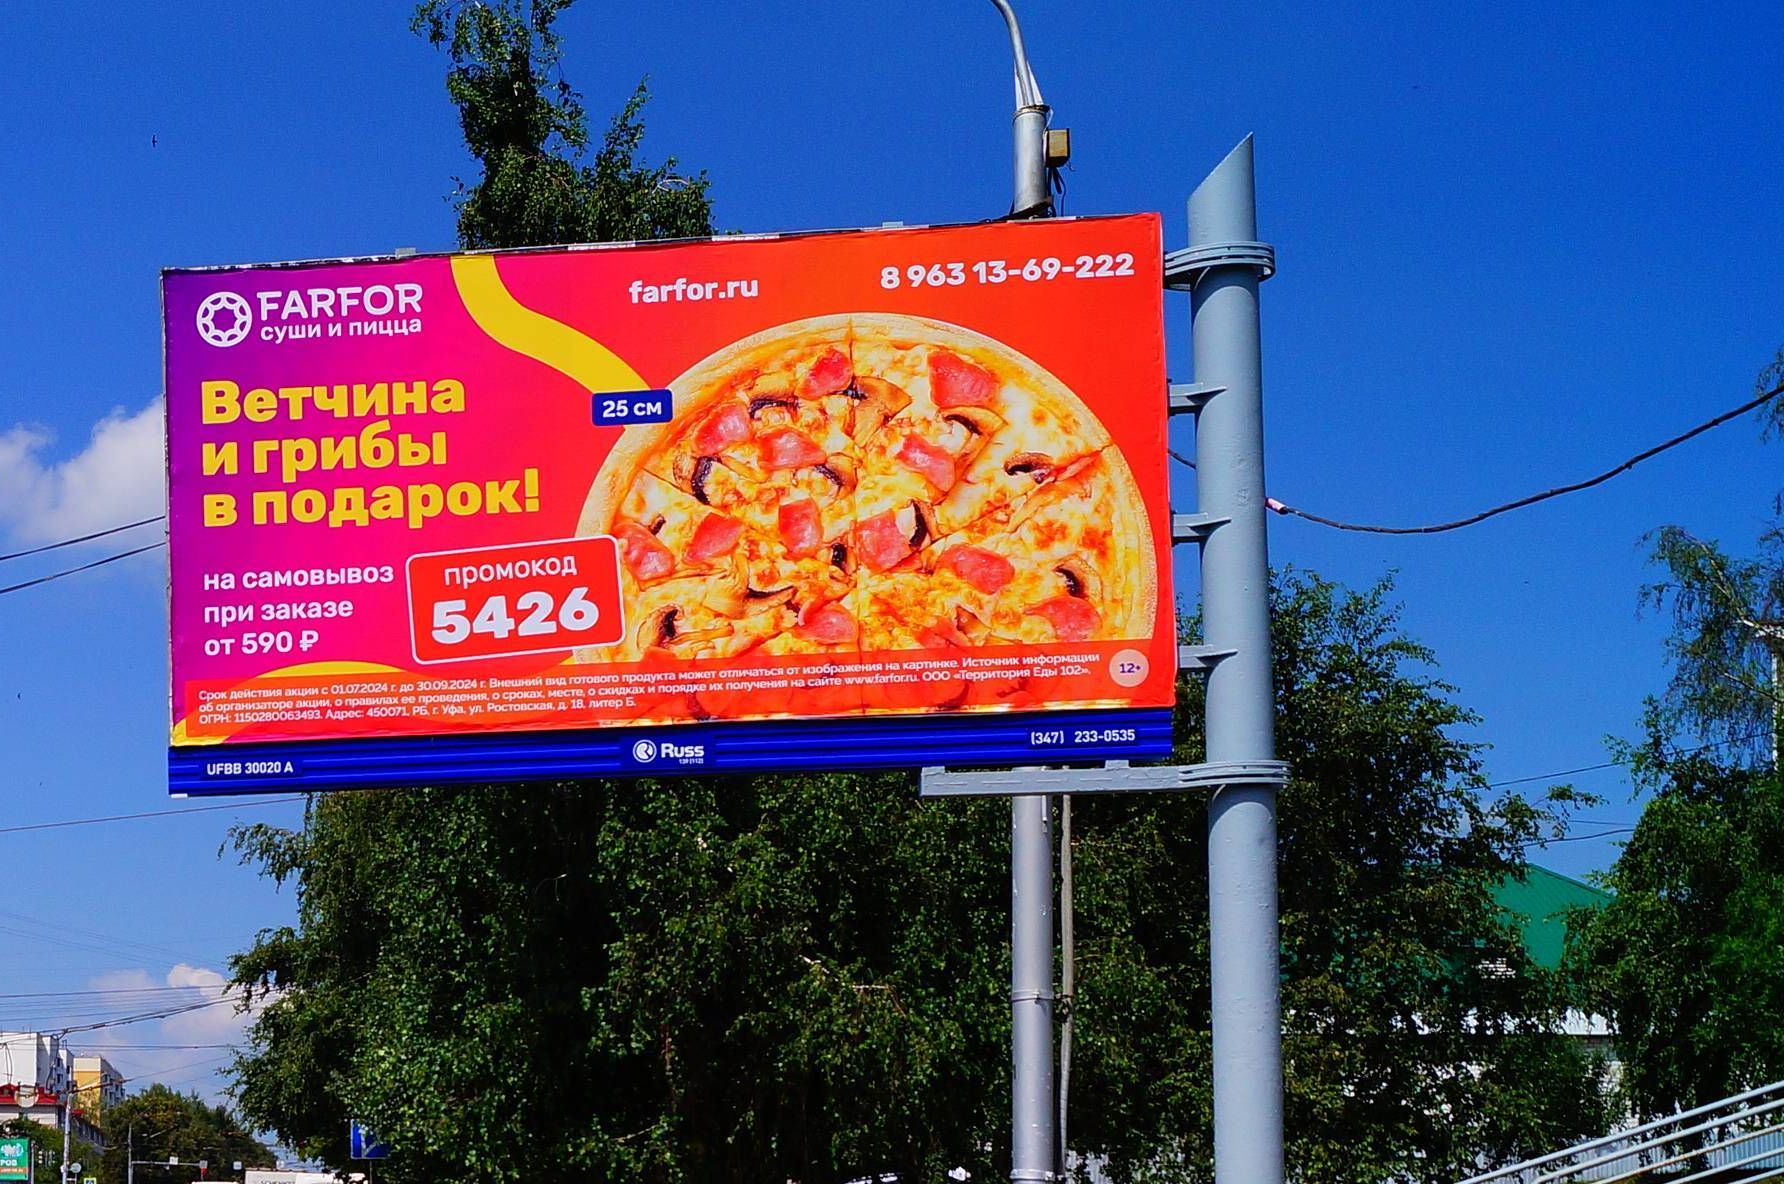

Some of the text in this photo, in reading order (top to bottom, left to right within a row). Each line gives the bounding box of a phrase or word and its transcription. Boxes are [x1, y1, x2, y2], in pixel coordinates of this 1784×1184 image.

[881, 253, 1135, 289] 8 963 13-69-222
[256, 283, 423, 321] FARFOR
[628, 275, 760, 305] farfor.ru
[260, 316, 423, 344] суши и пицца
[200, 378, 466, 425] Ветчина
[602, 400, 663, 418] 25 см
[201, 419, 448, 483] и грибы
[203, 467, 540, 529] в подарок!
[203, 565, 394, 591] на самовывоз
[444, 555, 577, 588] промокод
[204, 599, 354, 628] при заказе
[431, 586, 600, 645] 5426
[204, 638, 236, 656] от
[242, 631, 293, 654] 590
[199, 690, 227, 701] Срок
[230, 688, 282, 699] действия
[285, 688, 317, 698] акции
[321, 687, 328, 695] с
[399, 683, 414, 693] до
[417, 679, 477, 691] 30.09.2024
[489, 677, 542, 688] Внешний
[545, 677, 566, 686] вид
[569, 674, 619, 685] готового
[622, 672, 675, 683] продукта
[678, 670, 716, 680] может
[719, 667, 784, 678] отличаться
[787, 667, 800, 675] от
[803, 662, 883, 675] изображения
[885, 663, 900, 671] на
[903, 660, 959, 671] картинке.
[962, 656, 1019, 667] Источник
[1022, 653, 1100, 665] информации
[1119, 662, 1141, 674] 12+
[199, 702, 213, 712] об
[216, 700, 293, 713] организаторе
[334, 698, 342, 706] о
[345, 695, 398, 707] правилах
[401, 696, 415, 704] ее
[492, 692, 500, 700] о
[588, 688, 595, 696] о
[598, 684, 645, 696] скидках
[648, 685, 655, 693] и
[658, 683, 706, 694] порядке
[709, 682, 723, 690] их
[726, 679, 787, 692] получения
[791, 679, 805, 687] на
[808, 676, 841, 687] сайте
[922, 671, 950, 681] ООО
[953, 667, 1030, 681] «Территория
[1034, 666, 1057, 677] Еды
[199, 714, 231, 724] ОГРН:
[325, 708, 364, 720] Адрес:
[589, 698, 623, 709] литер
[661, 743, 705, 758] Russ
[1031, 729, 1135, 745] (347) 233-0535
[207, 761, 294, 775] UFBB 30020 A
